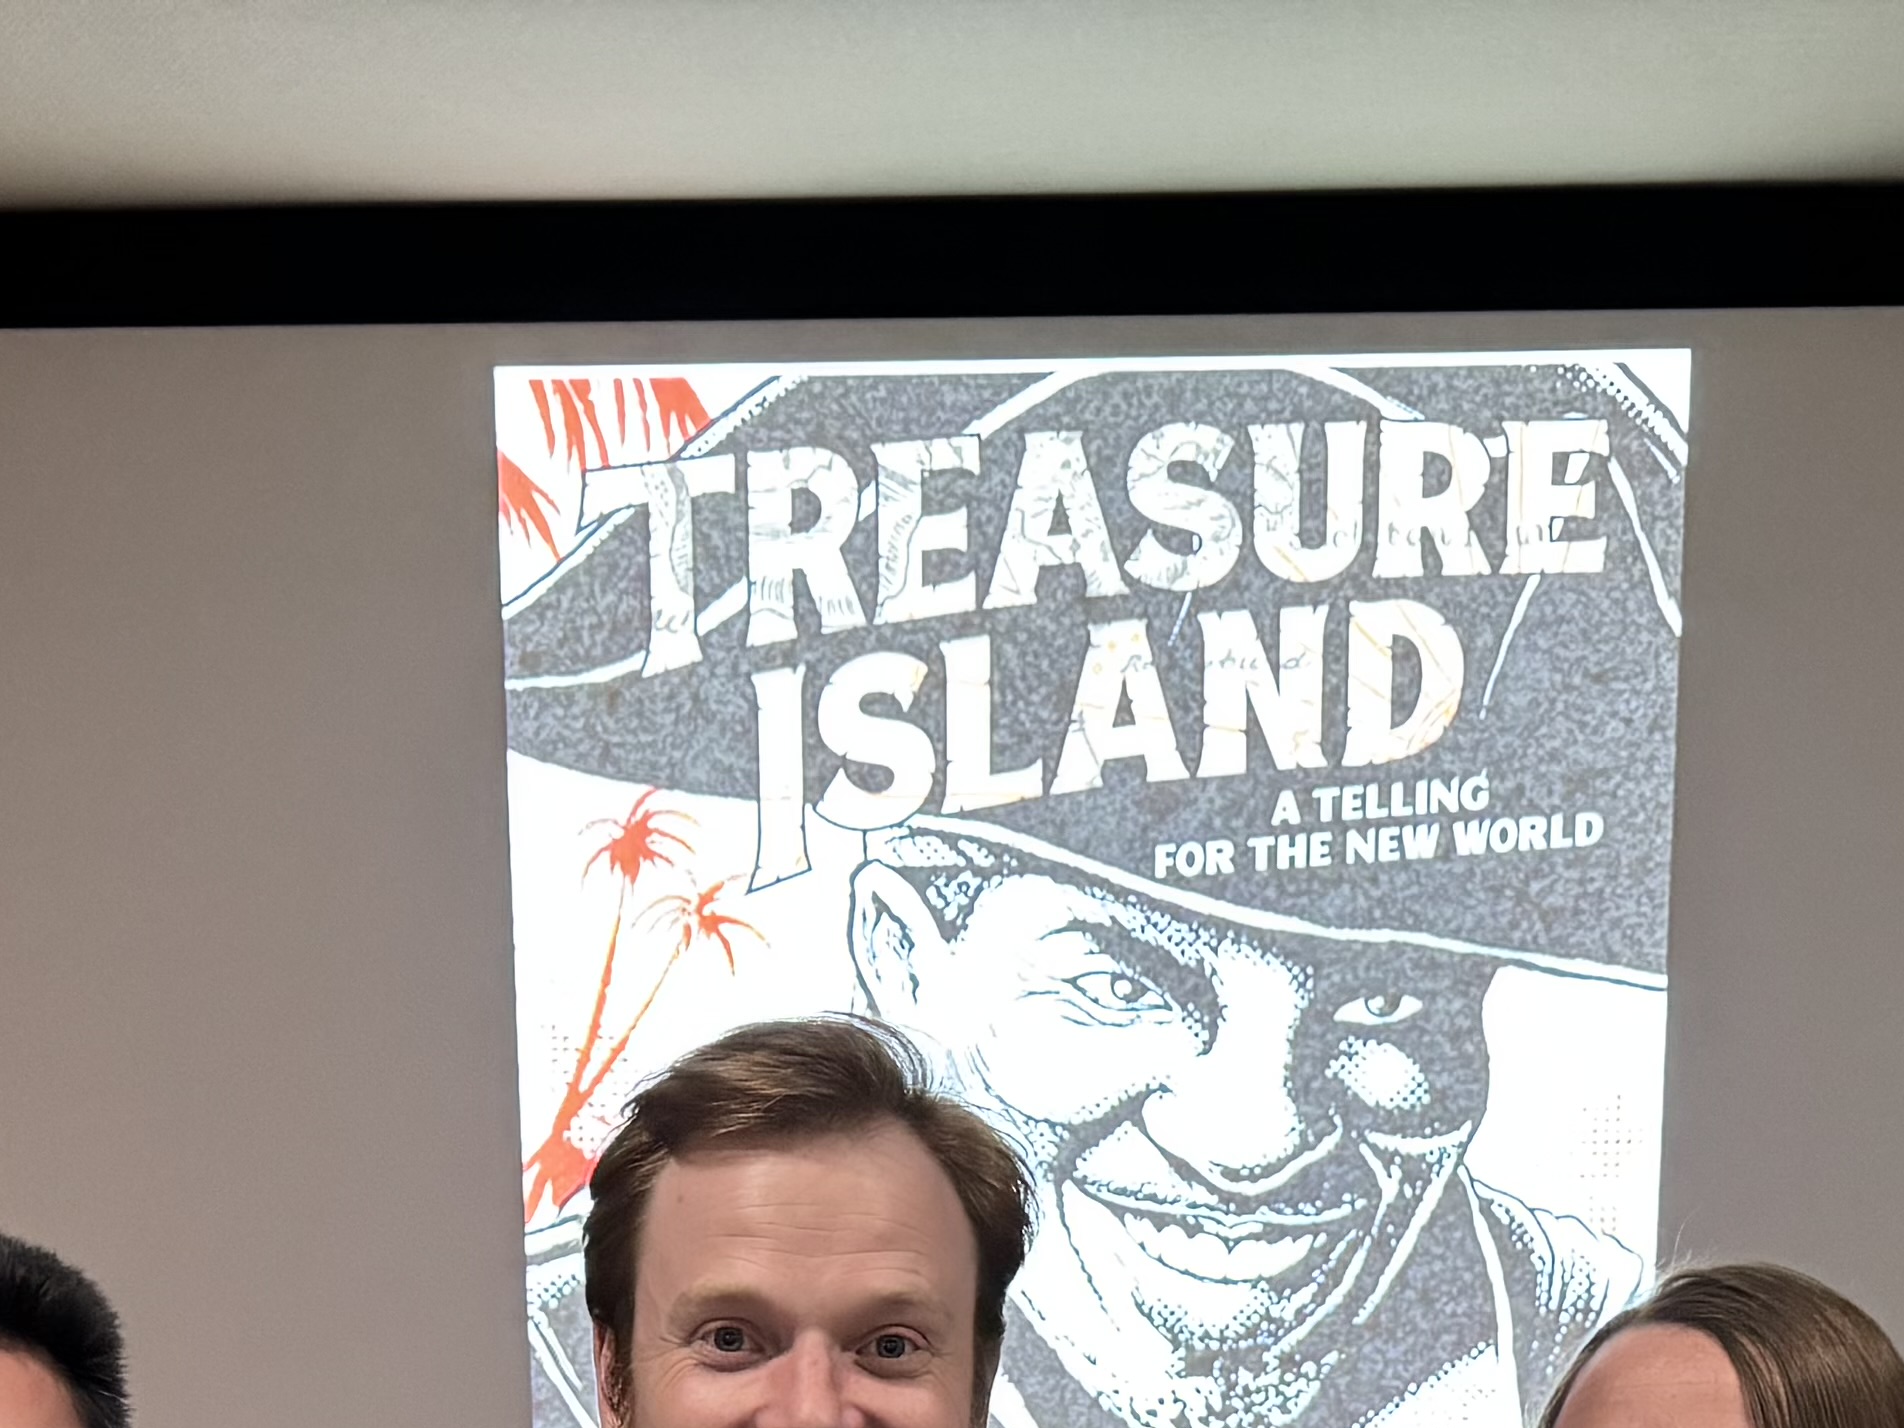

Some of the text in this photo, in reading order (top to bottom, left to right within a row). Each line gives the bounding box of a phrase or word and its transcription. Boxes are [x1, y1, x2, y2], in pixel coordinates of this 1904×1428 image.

[576, 416, 1610, 677] TREASURE
[748, 599, 1465, 894] ISLAND
[1270, 768, 1491, 826] A TELLING
[1153, 811, 1605, 879] FOR THE NEW WORLD
